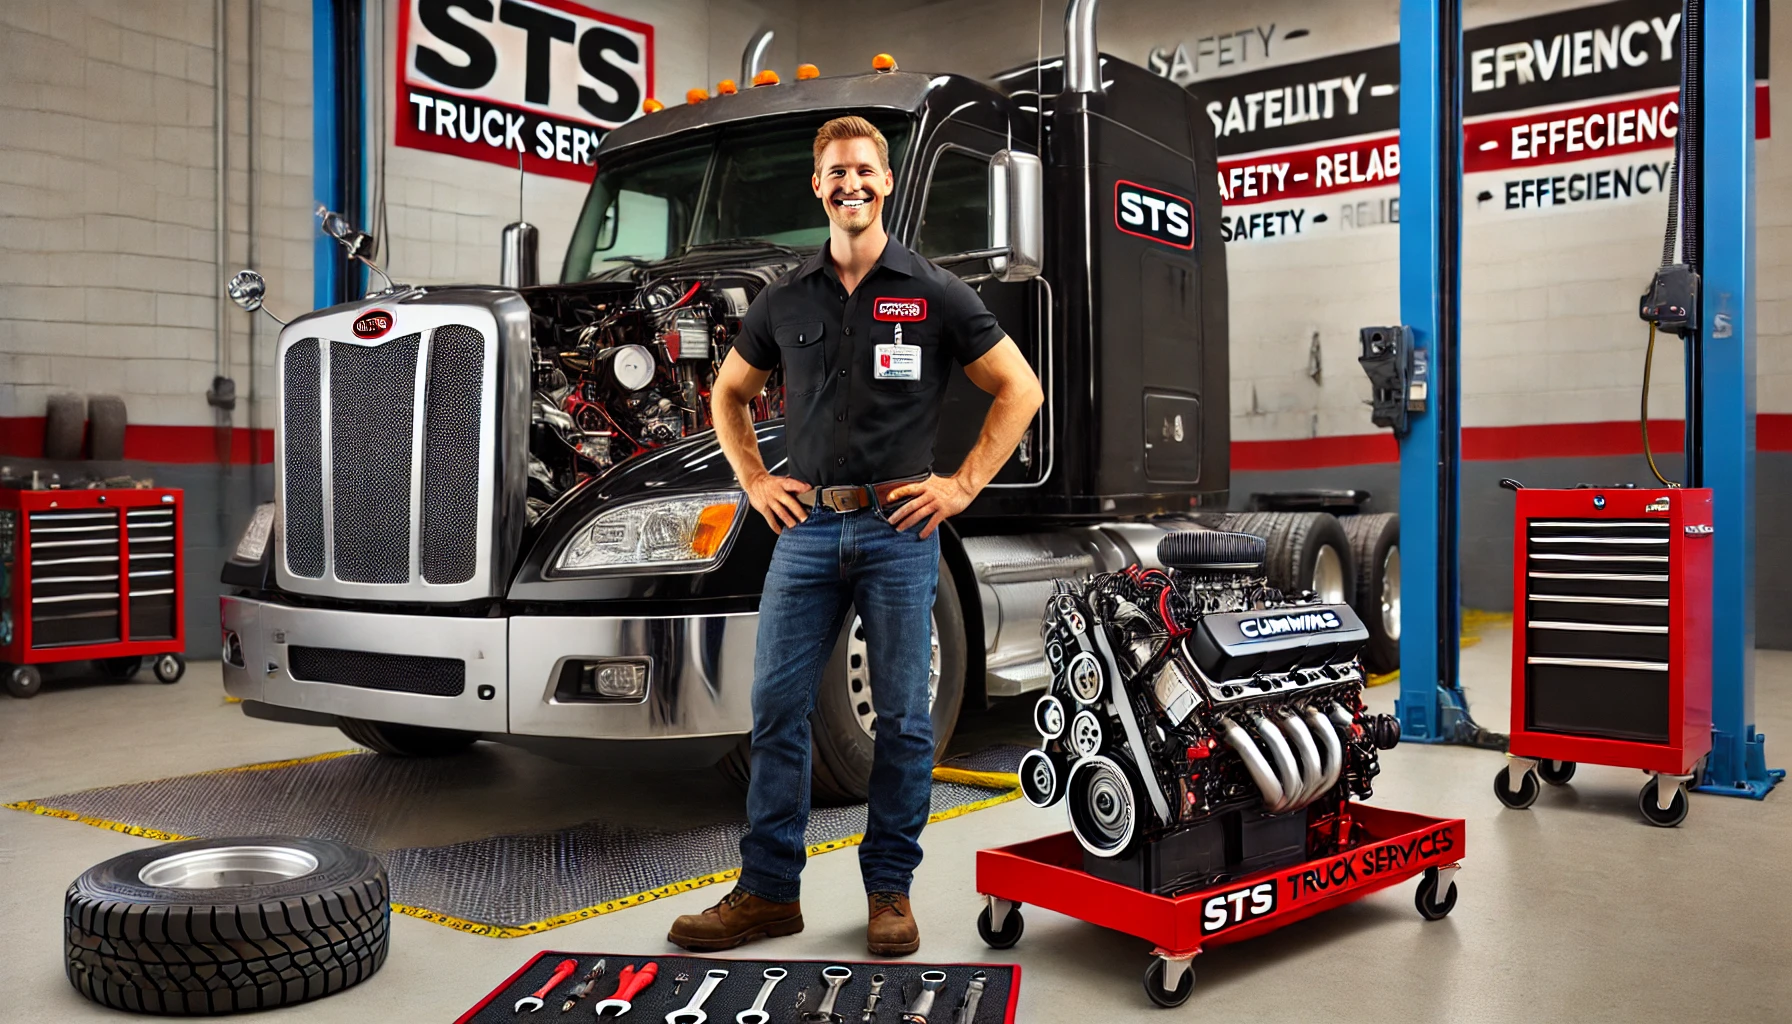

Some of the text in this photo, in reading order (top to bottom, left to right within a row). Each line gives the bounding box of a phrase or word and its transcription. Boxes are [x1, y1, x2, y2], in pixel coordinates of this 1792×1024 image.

[415, 0, 641, 123] STS
[1148, 23, 1276, 80] SAFETY
[410, 93, 526, 153] TRUCK
[1316, 144, 1400, 188] RELAB
[1121, 192, 1189, 238] STS
[1220, 209, 1304, 242] SAFETY
[1204, 827, 1454, 931] STS TRUCK SERVICES
